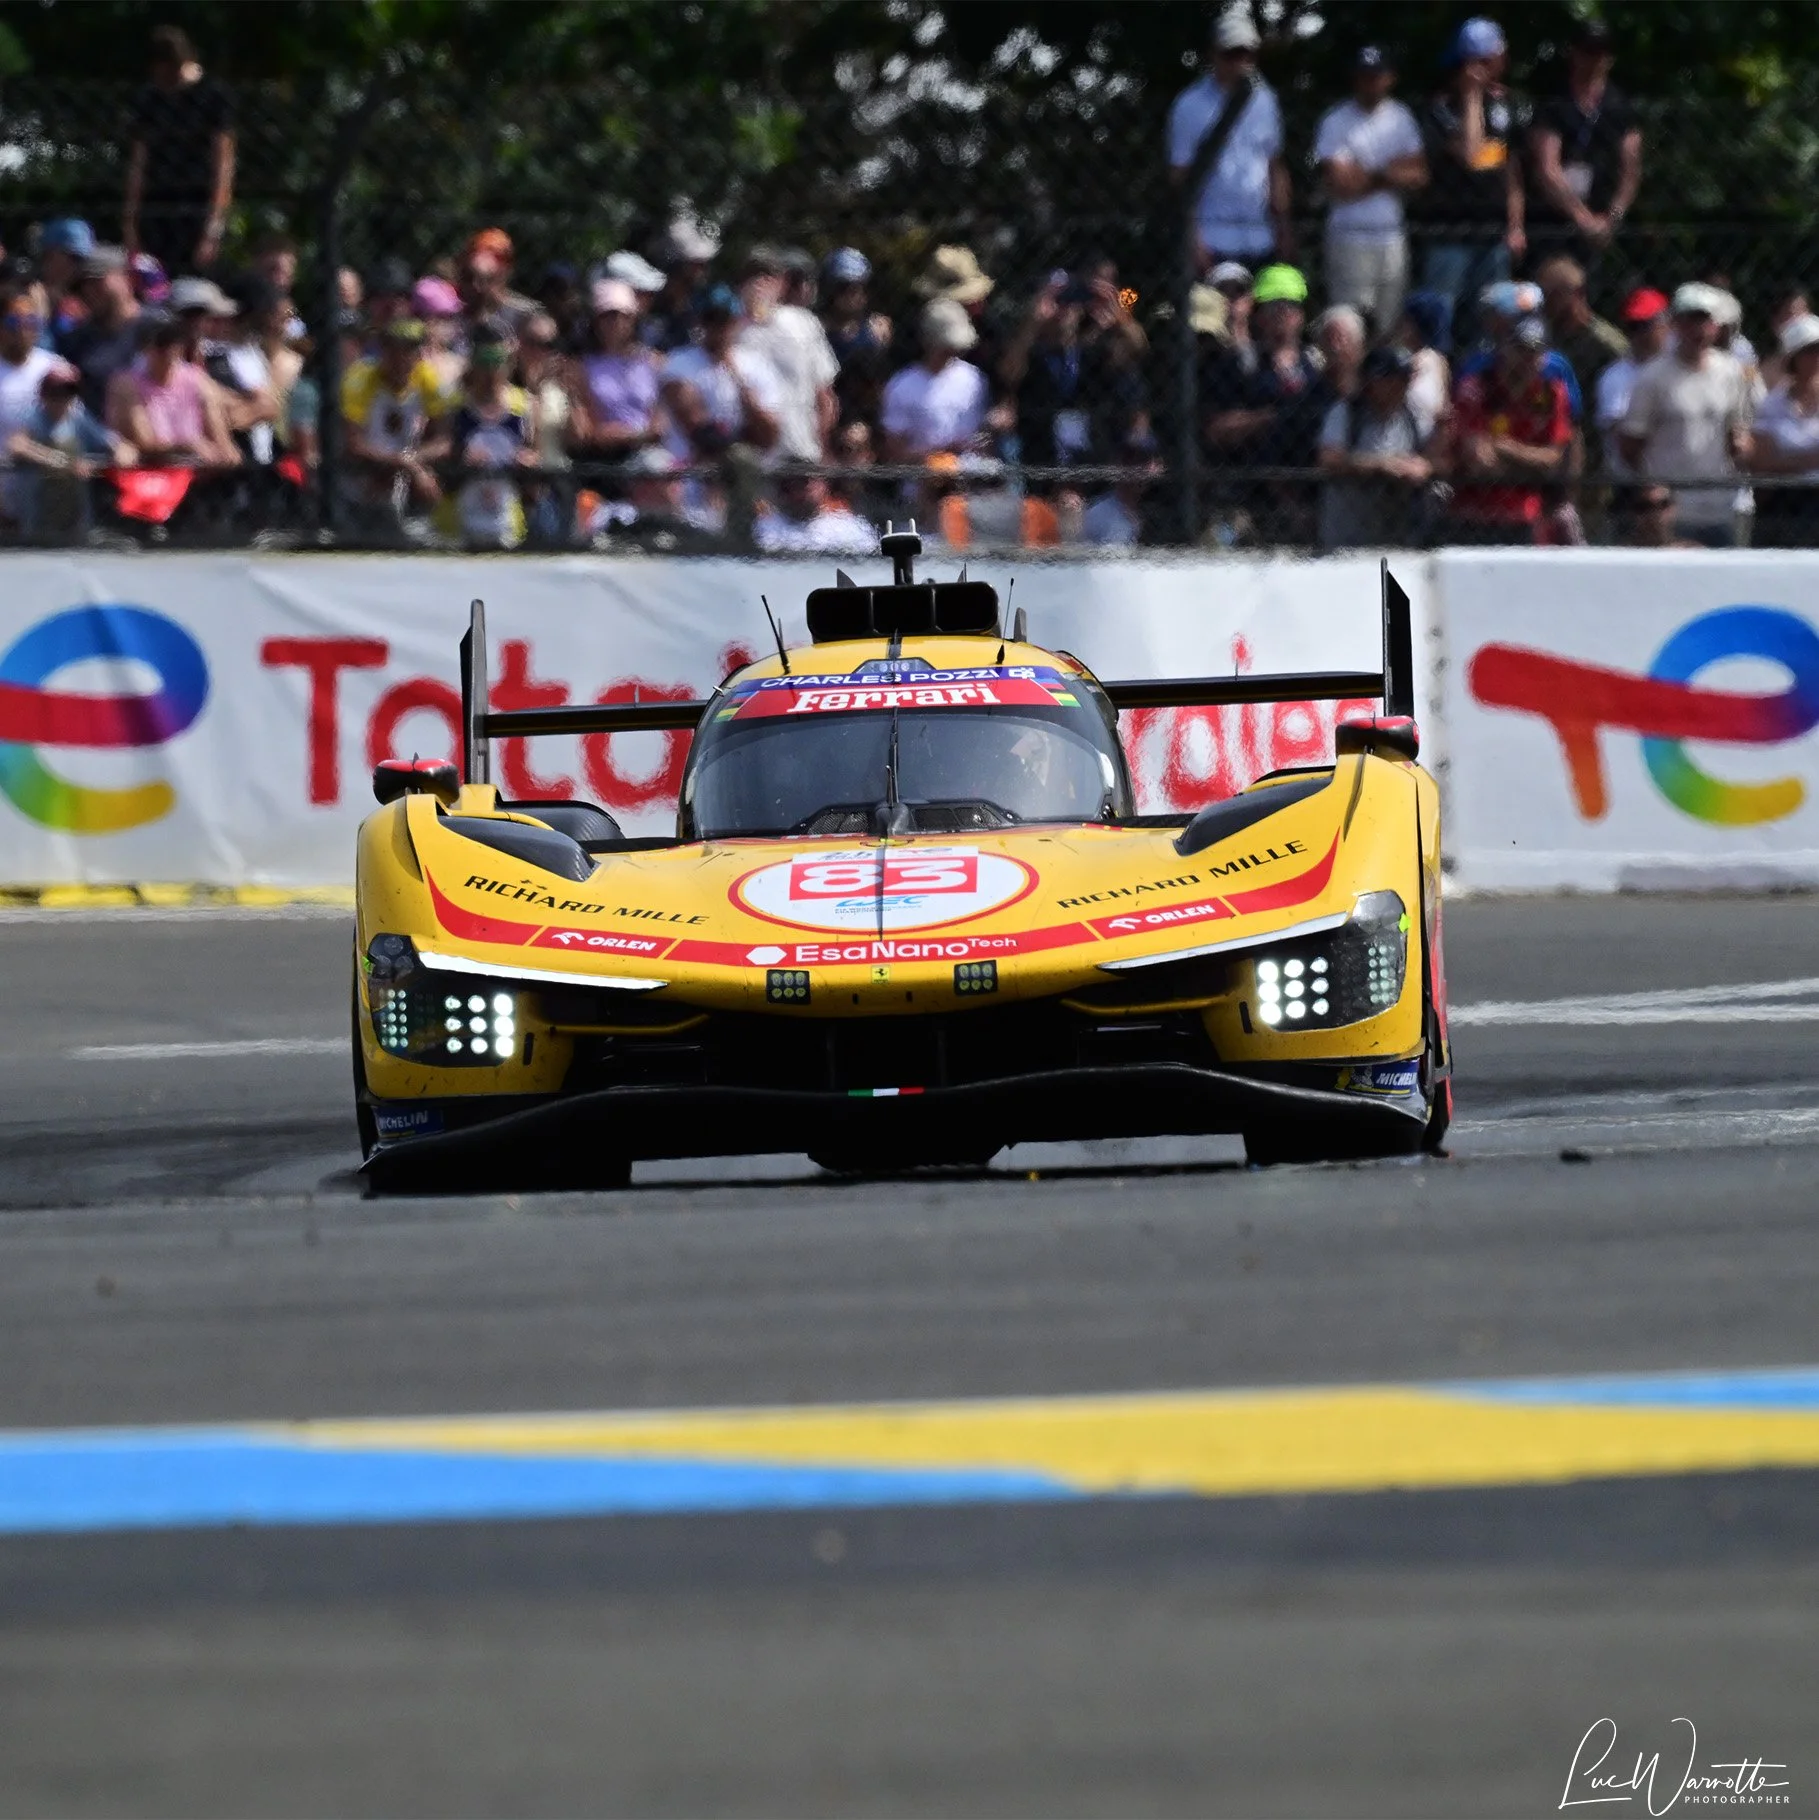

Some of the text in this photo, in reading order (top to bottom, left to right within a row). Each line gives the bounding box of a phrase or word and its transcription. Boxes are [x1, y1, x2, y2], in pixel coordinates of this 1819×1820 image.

[761, 673, 901, 688] CHARLES
[910, 668, 1000, 682] POZZI
[787, 683, 1002, 713] Ferrari
[799, 859, 968, 893] 83
[1056, 840, 1308, 909] RICHARD MILLE
[464, 875, 710, 926] RICHARD MILLE
[1145, 904, 1216, 924] ORLEN
[587, 935, 657, 951] ORLEN
[1376, 1072, 1418, 1086] MICHEL
